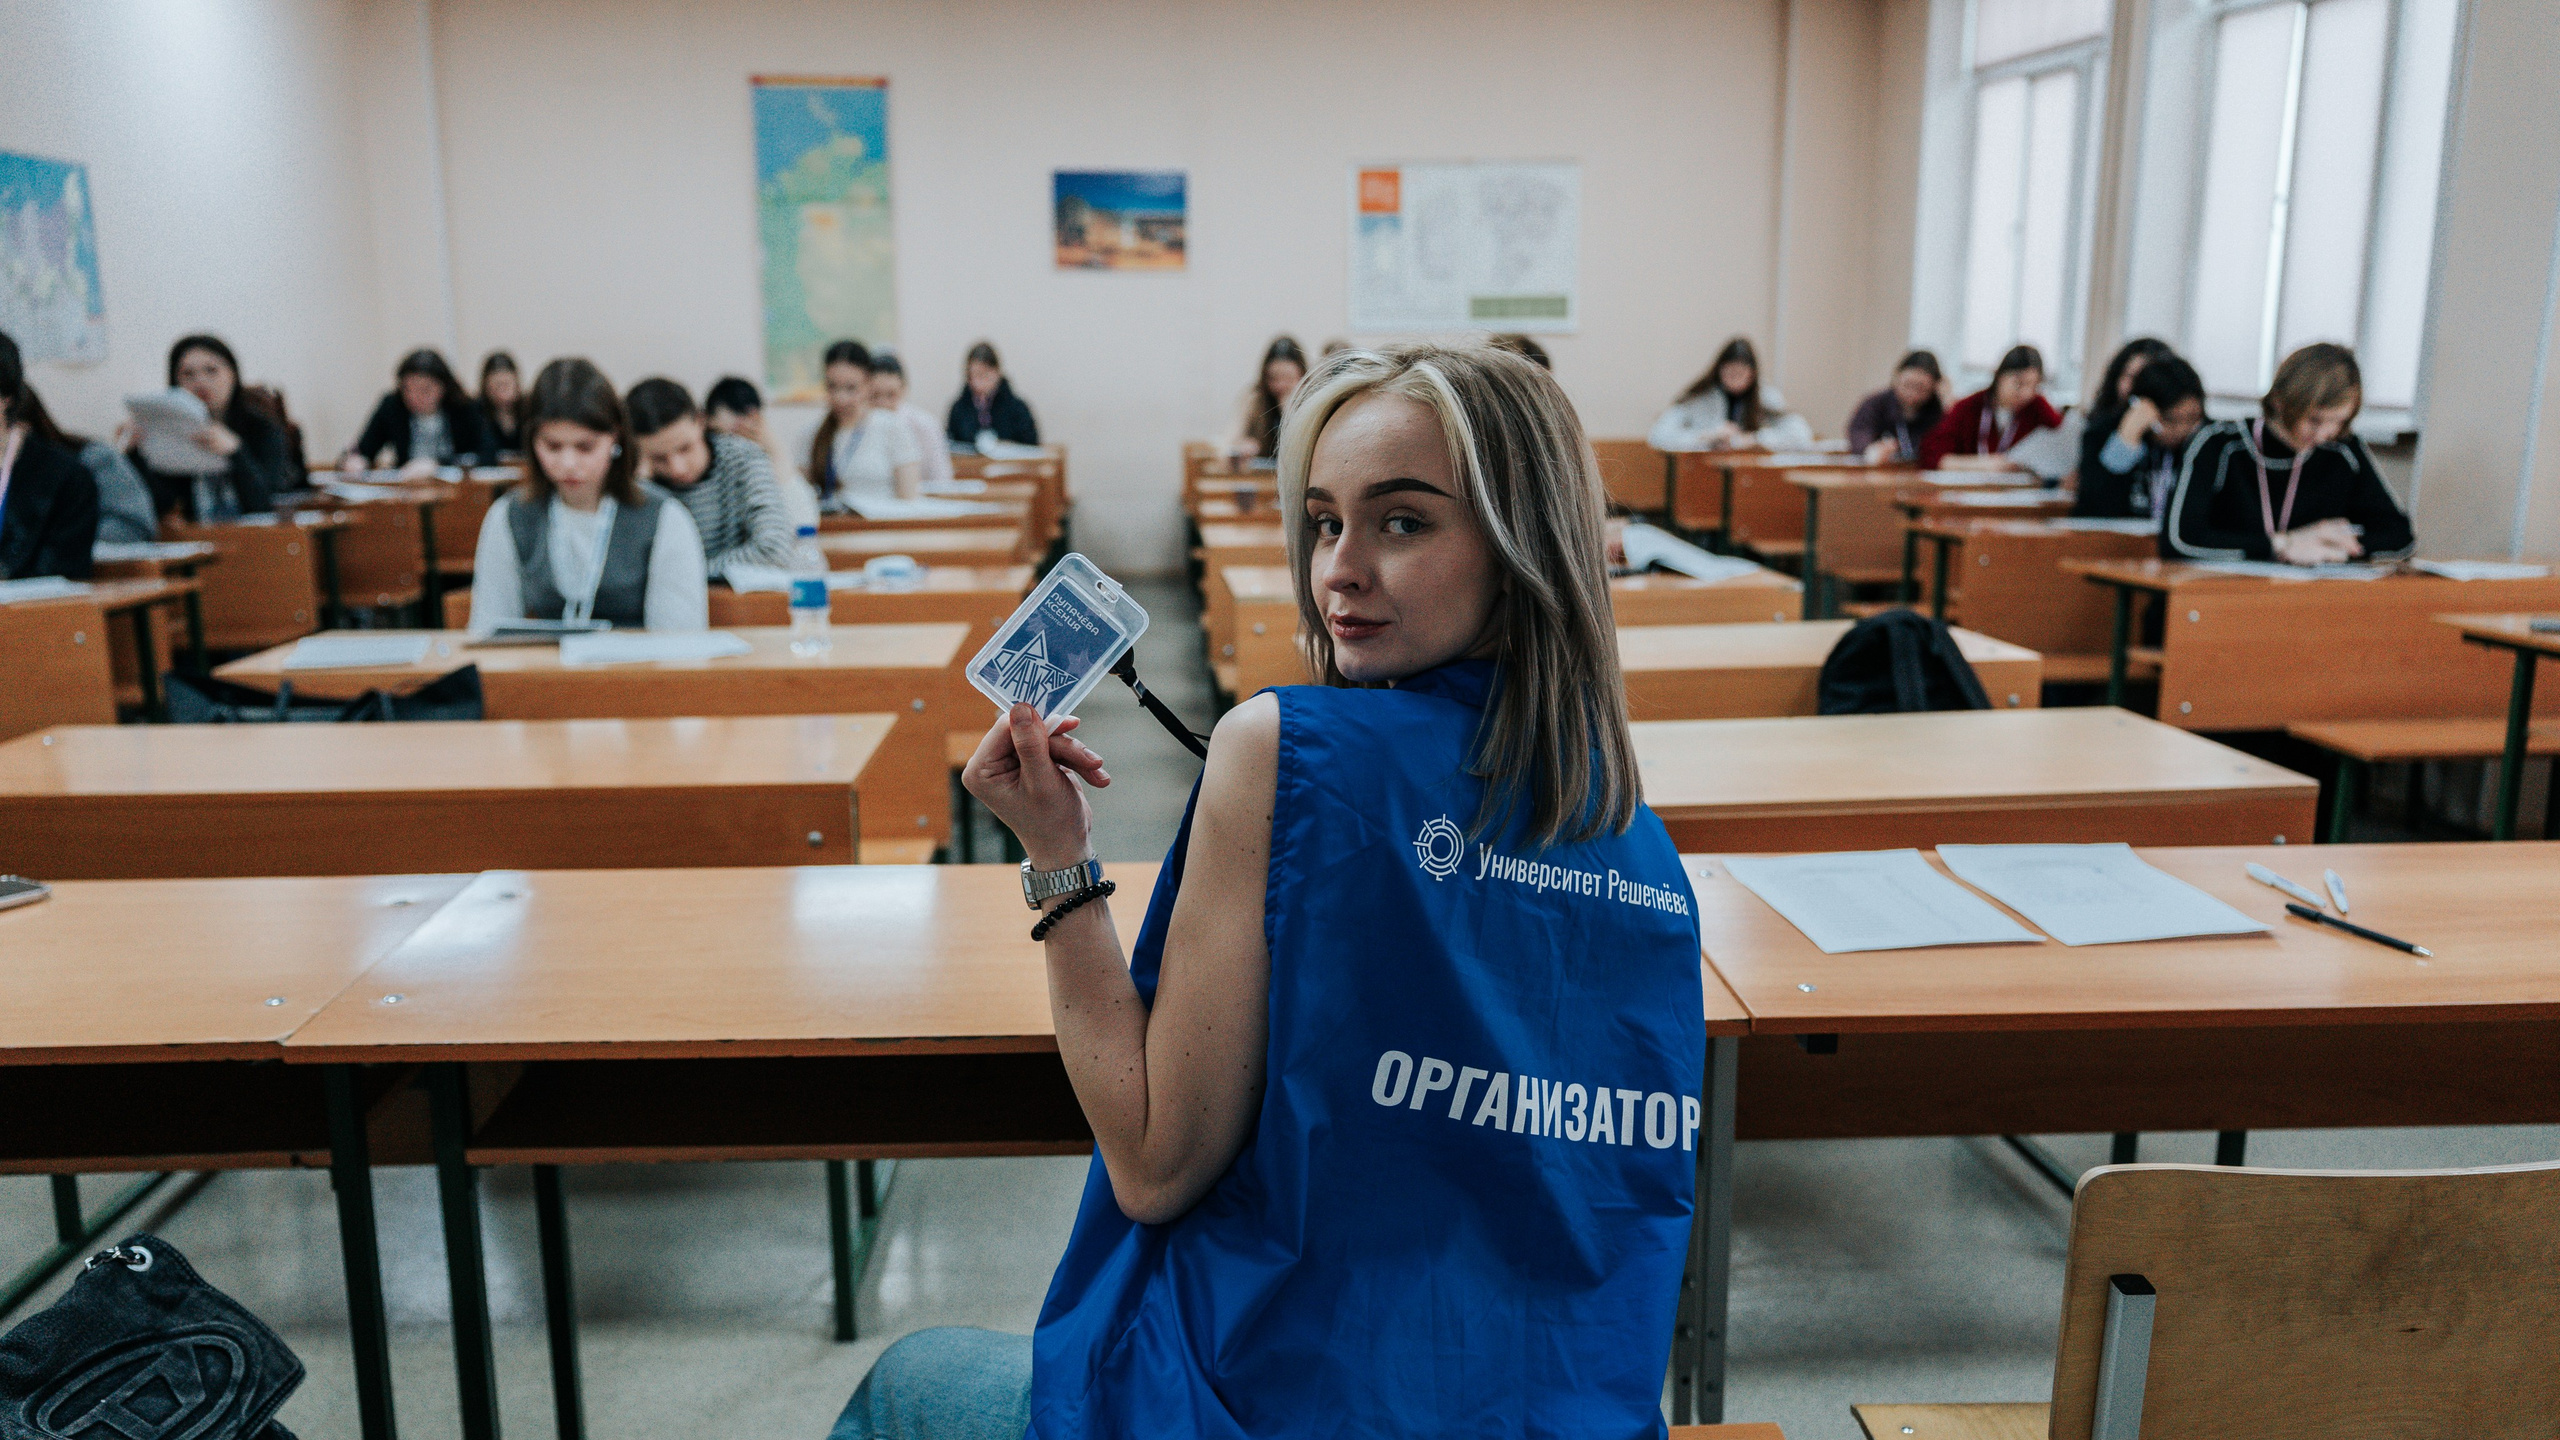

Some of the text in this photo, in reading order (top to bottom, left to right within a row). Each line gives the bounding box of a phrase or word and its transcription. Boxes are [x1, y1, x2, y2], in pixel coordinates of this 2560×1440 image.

[1045, 599, 1081, 632] КСЕНИЯ
[1475, 842, 1690, 917] Университет Решетнёва
[1371, 1050, 1701, 1151] ОРГАНИЗАТОР
